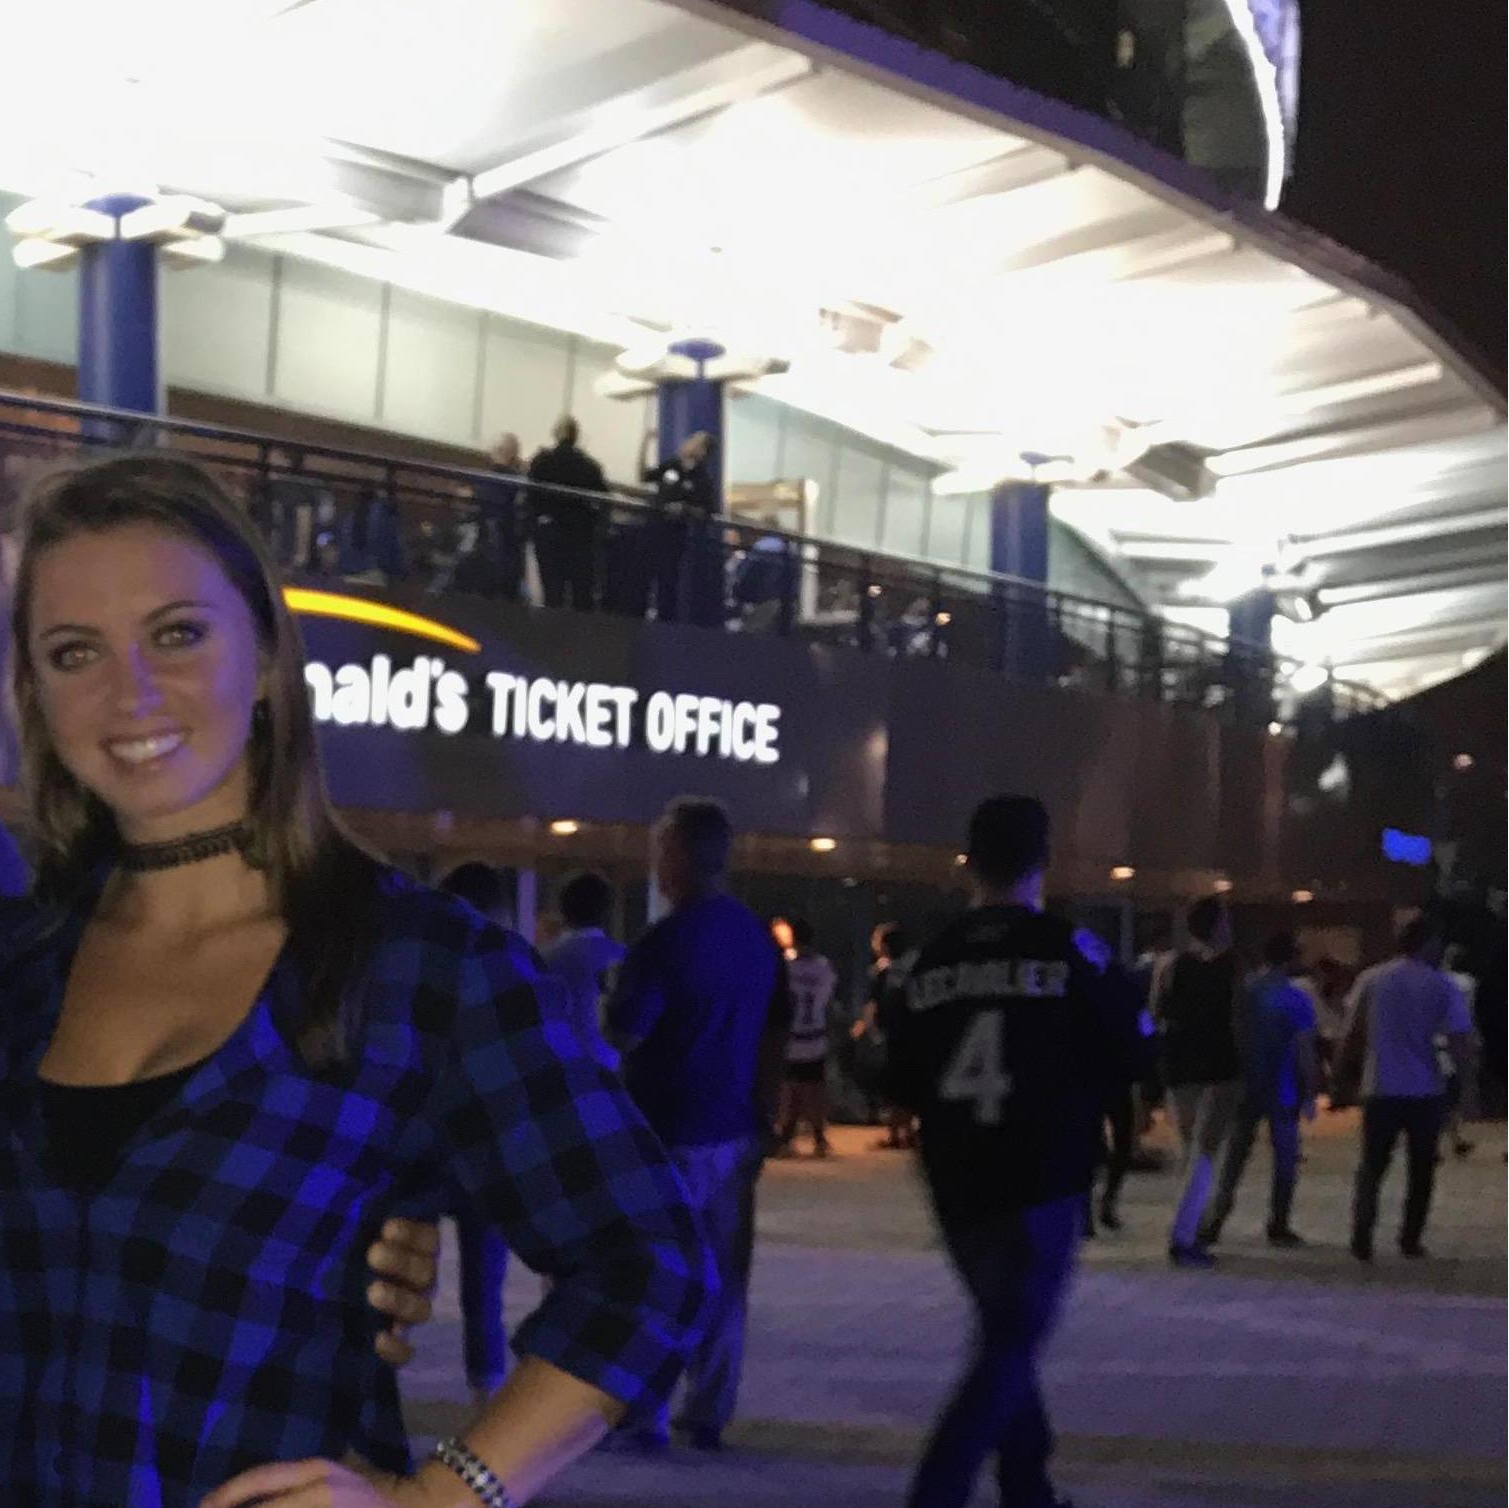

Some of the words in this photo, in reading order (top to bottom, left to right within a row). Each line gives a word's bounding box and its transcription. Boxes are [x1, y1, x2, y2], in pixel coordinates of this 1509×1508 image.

[486, 671, 638, 747] TICKET
[646, 690, 781, 764] OFFICE
[941, 1010, 1014, 1125] 4
